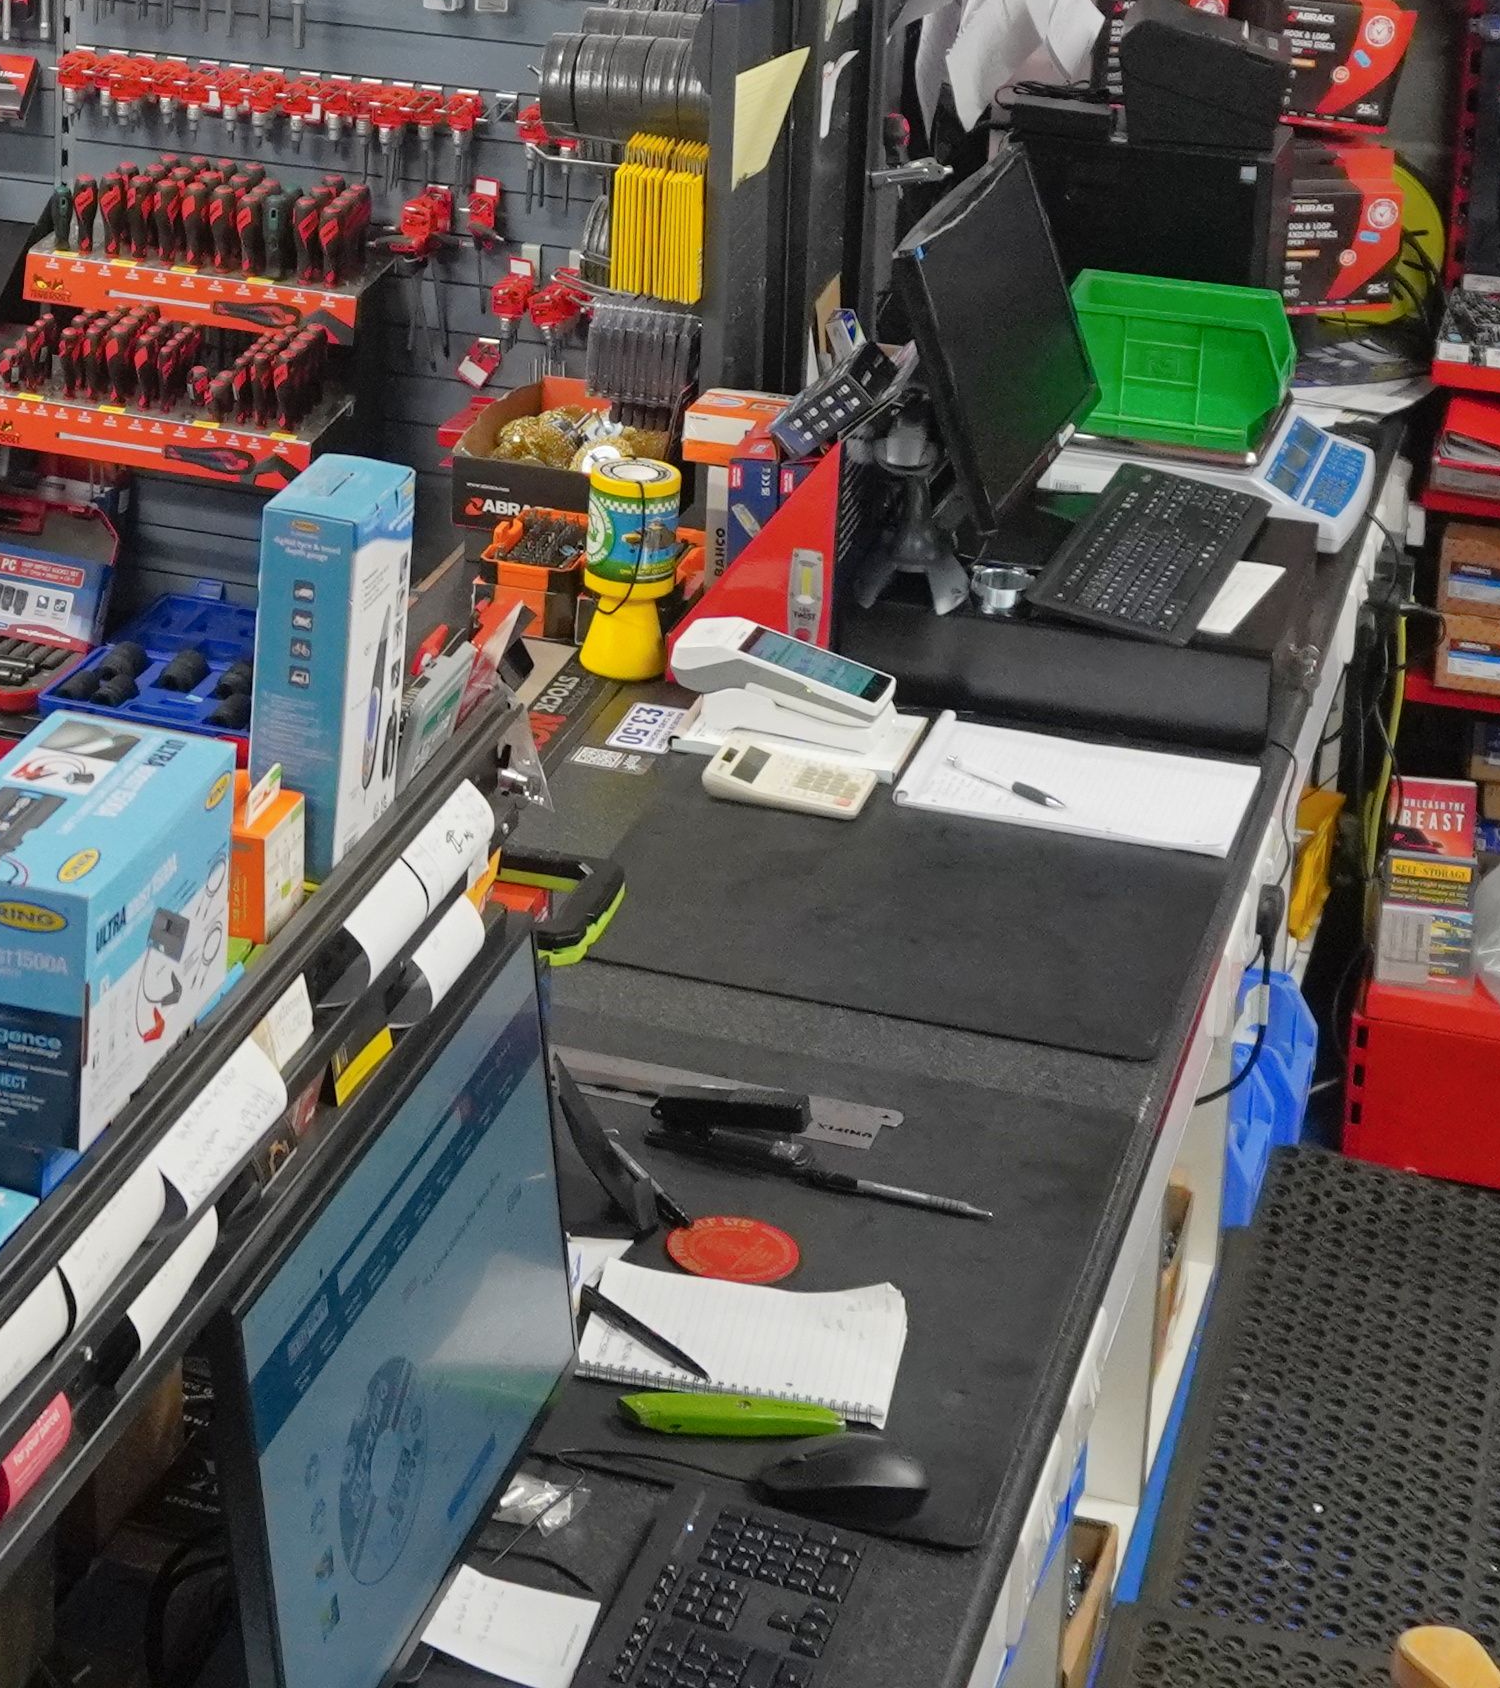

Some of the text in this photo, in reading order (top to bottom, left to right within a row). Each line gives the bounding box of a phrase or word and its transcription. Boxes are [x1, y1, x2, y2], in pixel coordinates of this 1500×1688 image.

[1296, 11, 1336, 24] ABRACS
[1294, 203, 1335, 213] ABRACS
[1313, 222, 1332, 231] LOOP
[714, 526, 727, 577] BAHCO
[0, 556, 18, 572] PC
[1460, 641, 1491, 651] ABRACS
[539, 674, 580, 715] STOCK
[615, 706, 664, 748] £3.50
[1403, 798, 1466, 811] UNLEASH THE
[1400, 810, 1466, 832] BEAST
[95, 904, 127, 954] ULTRA
